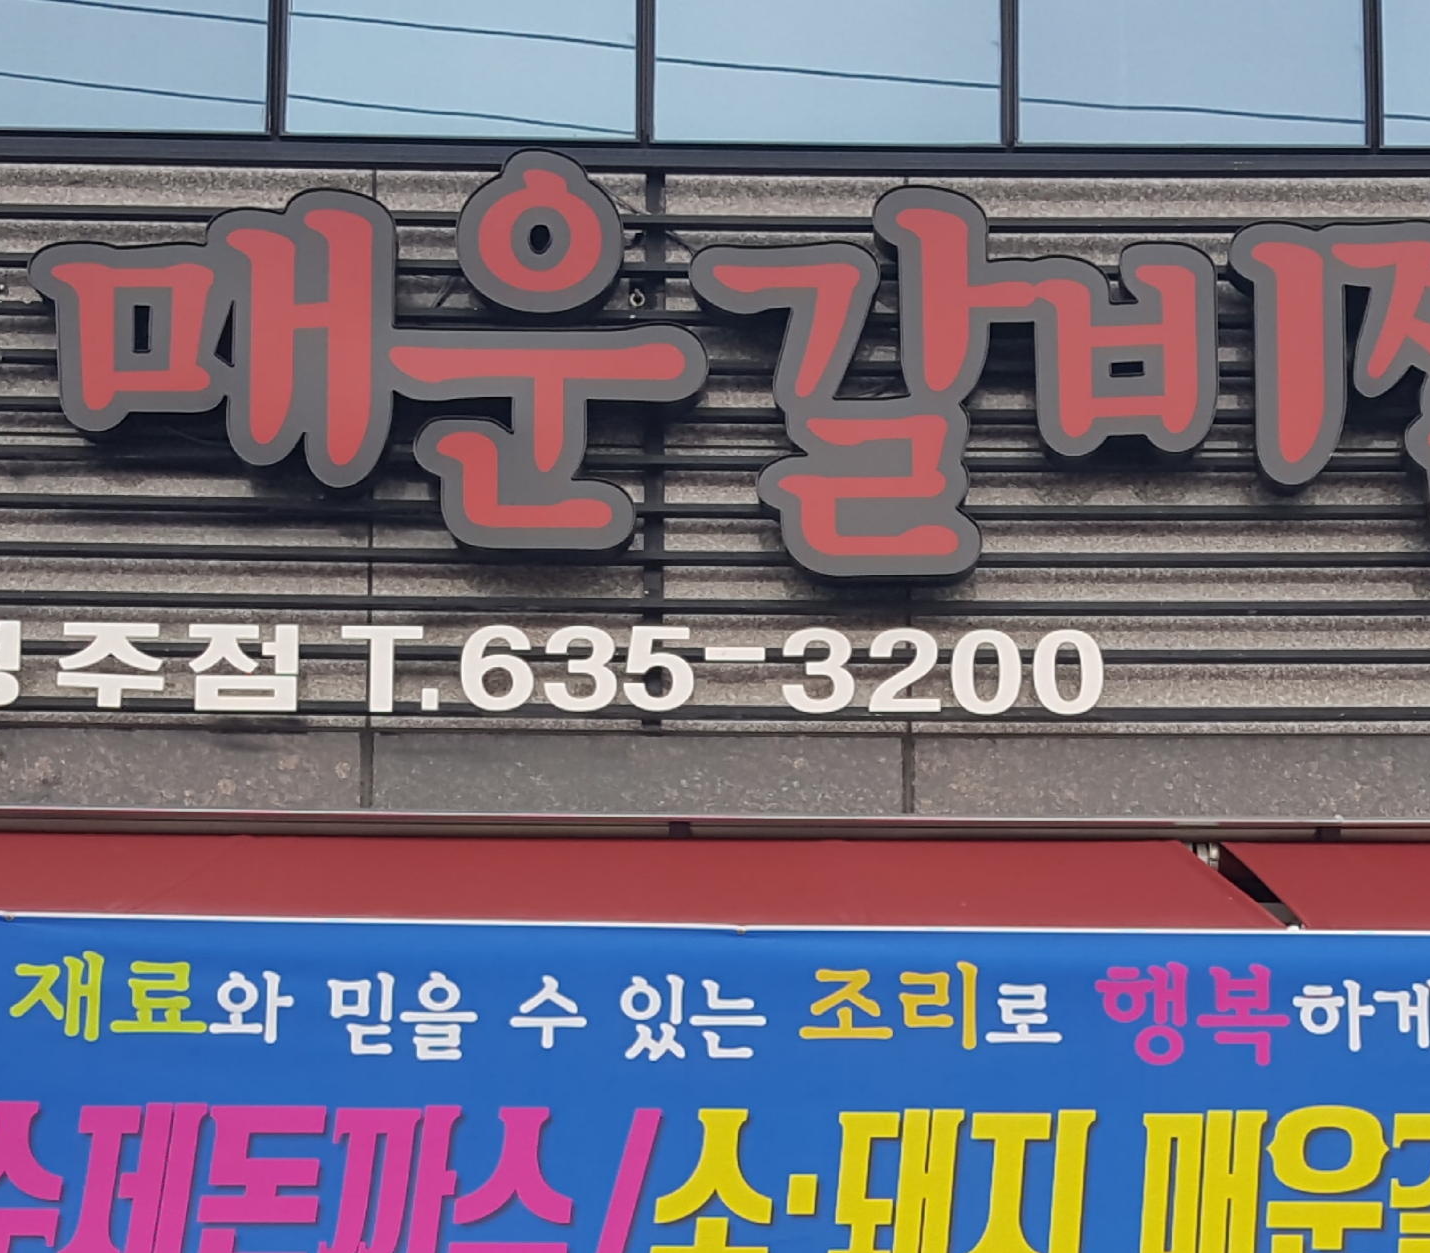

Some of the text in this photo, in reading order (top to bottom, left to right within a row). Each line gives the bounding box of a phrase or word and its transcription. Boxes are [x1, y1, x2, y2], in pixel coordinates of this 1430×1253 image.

[340, 624, 1104, 714] T.635-3200
[9, 950, 294, 1045] 재료와
[327, 970, 477, 1062] 믿을
[508, 975, 588, 1048] 수
[619, 974, 766, 1062] 있는
[798, 961, 1063, 1049] 조리로
